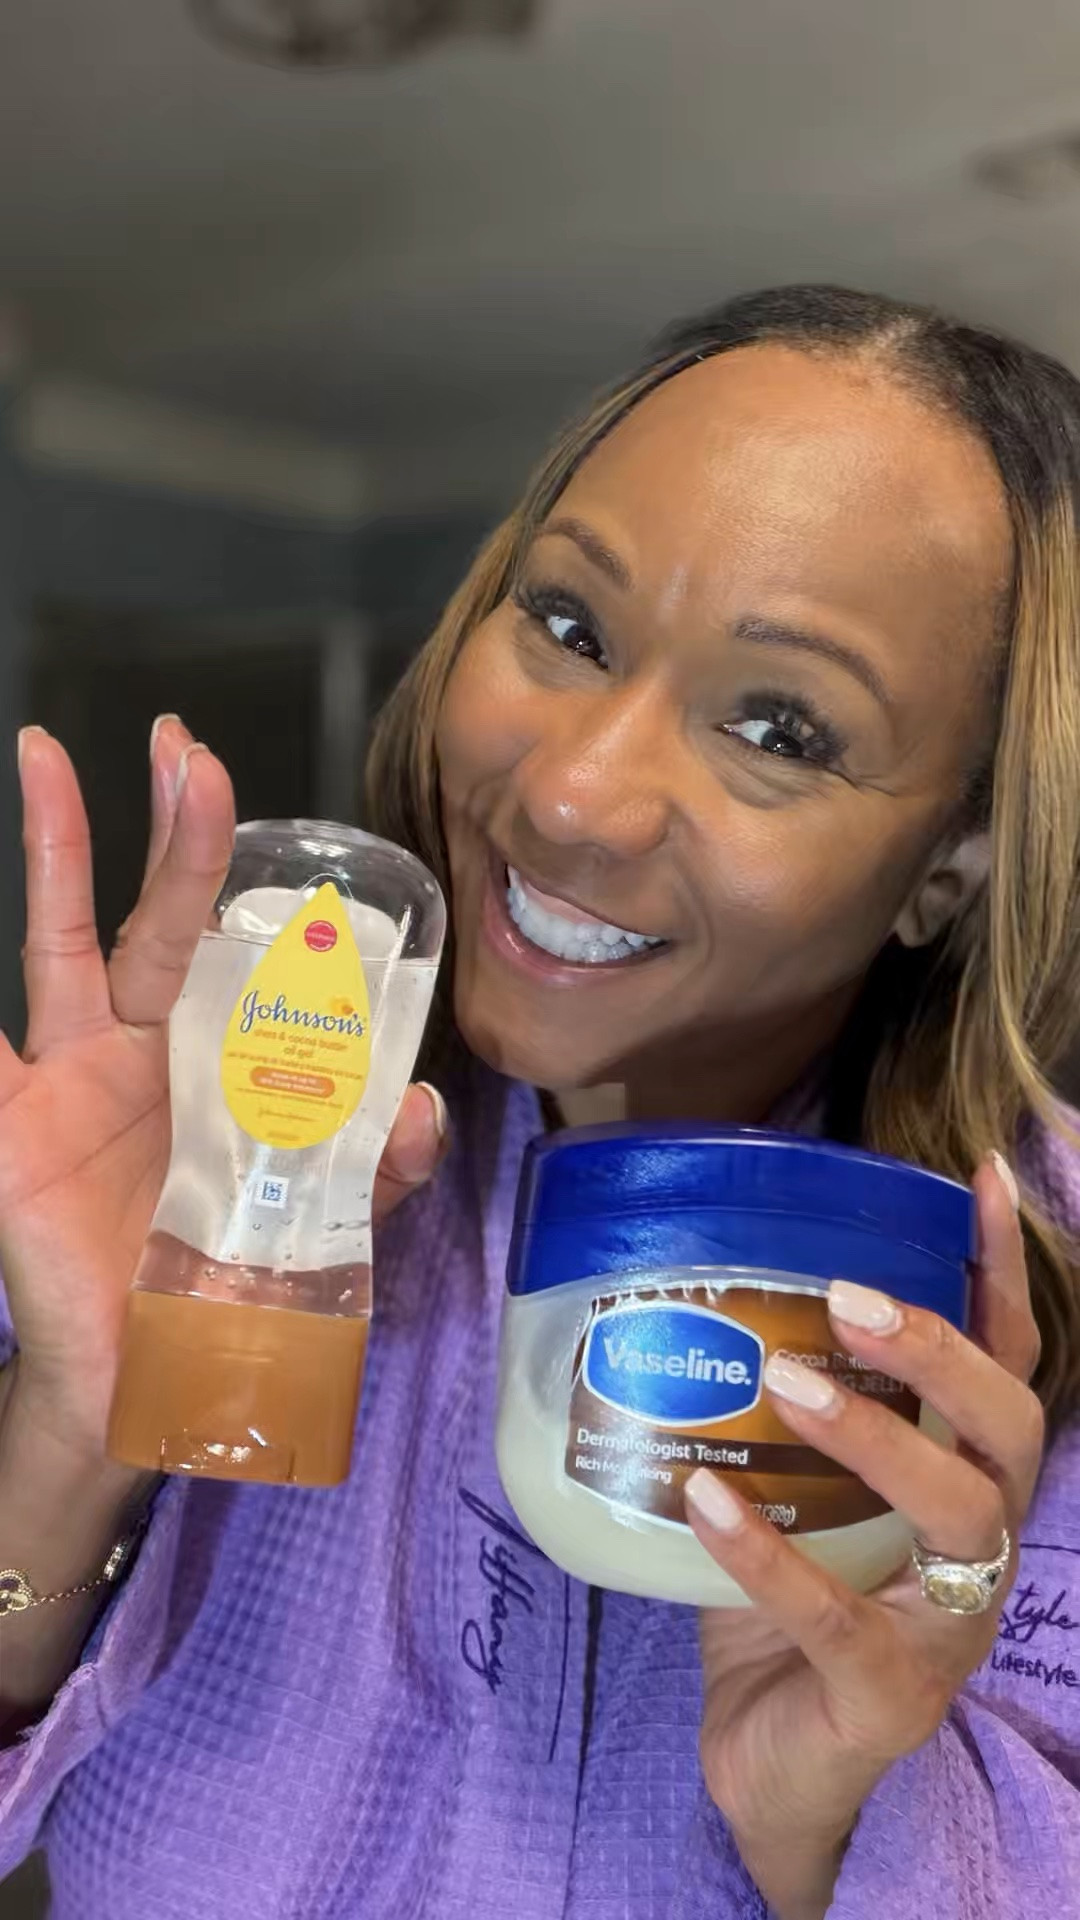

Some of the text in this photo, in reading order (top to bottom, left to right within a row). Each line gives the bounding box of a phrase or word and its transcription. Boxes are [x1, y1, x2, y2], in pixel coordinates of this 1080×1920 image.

[240, 990, 365, 1037] Johnson's
[575, 1455, 600, 1472] Rich
[576, 1428, 749, 1465] Dermatologist Tested
[991, 1649, 1080, 1688] Lifestyle
